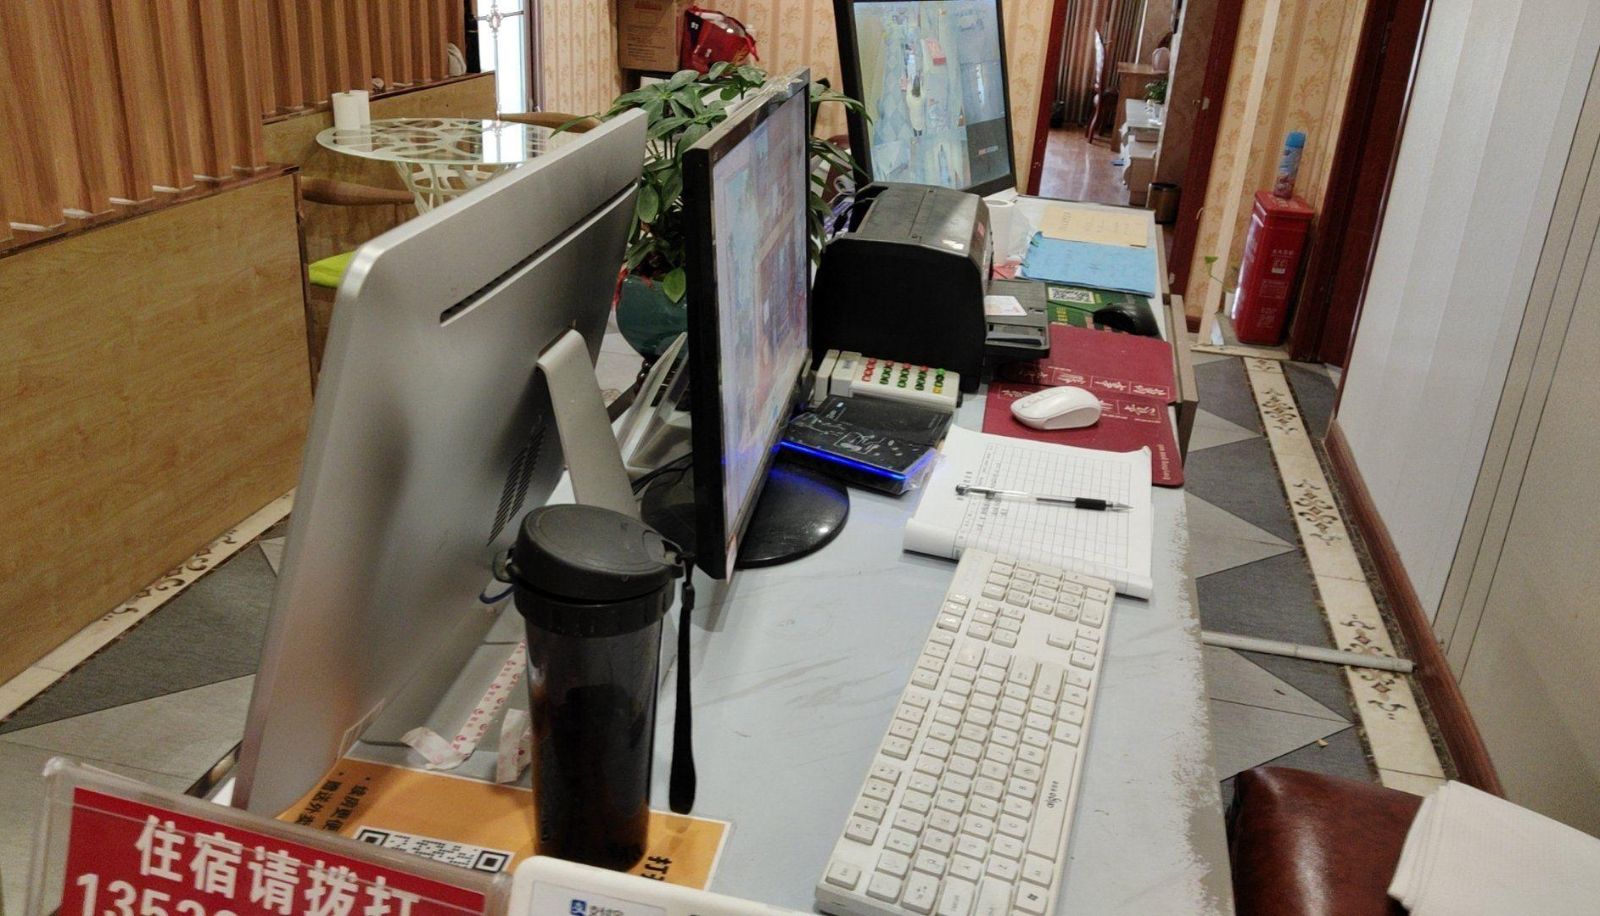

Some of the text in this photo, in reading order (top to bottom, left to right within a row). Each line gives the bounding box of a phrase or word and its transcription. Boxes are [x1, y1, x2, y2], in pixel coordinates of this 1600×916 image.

[135, 814, 422, 916] 住宿请拨打
